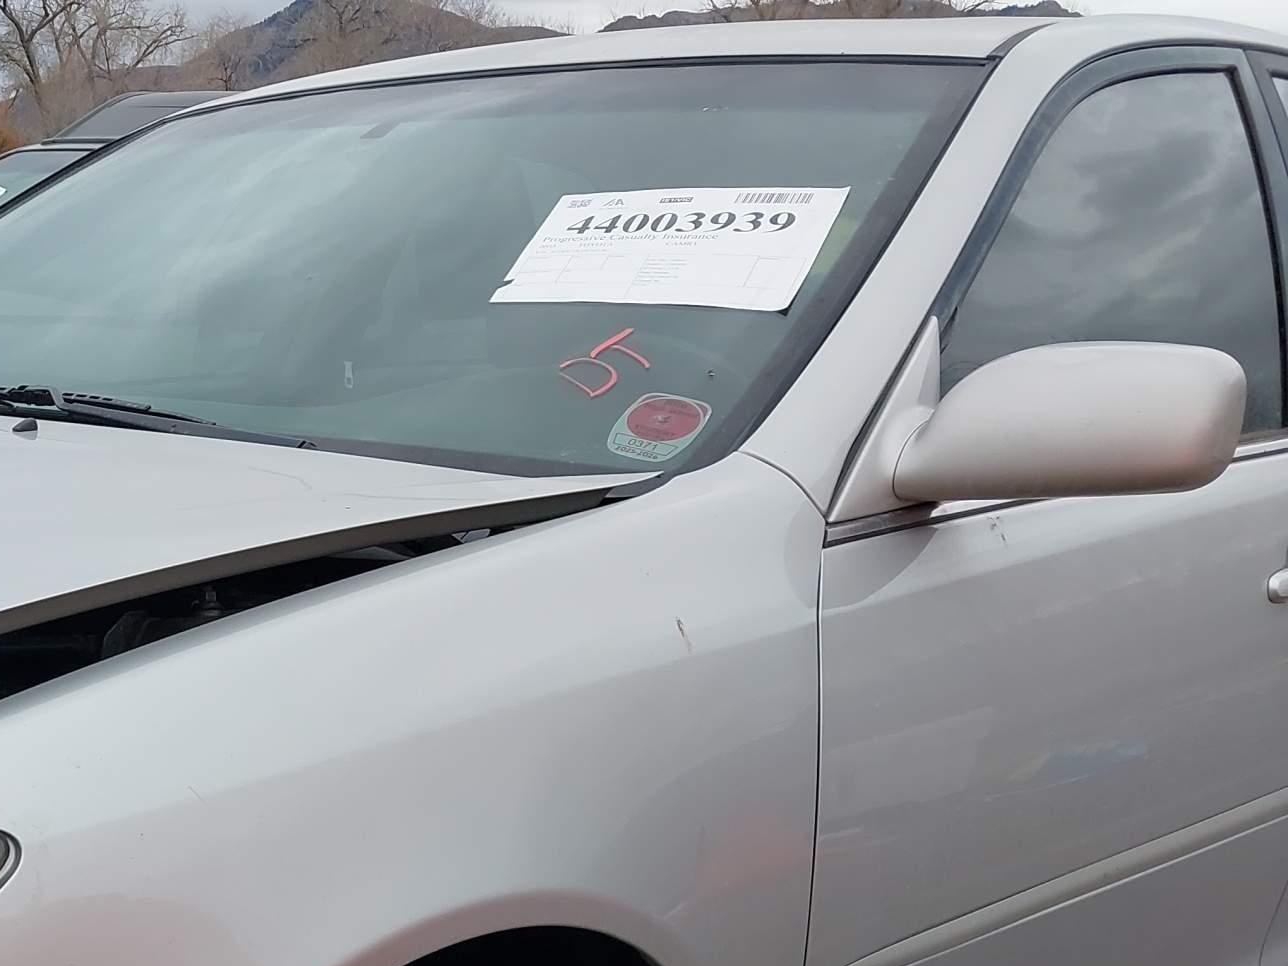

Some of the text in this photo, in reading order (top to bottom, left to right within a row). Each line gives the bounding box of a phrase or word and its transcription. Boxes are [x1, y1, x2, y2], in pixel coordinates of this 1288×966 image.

[566, 211, 797, 234] 44003939
[543, 232, 720, 243] Progressive Casualty Insurance
